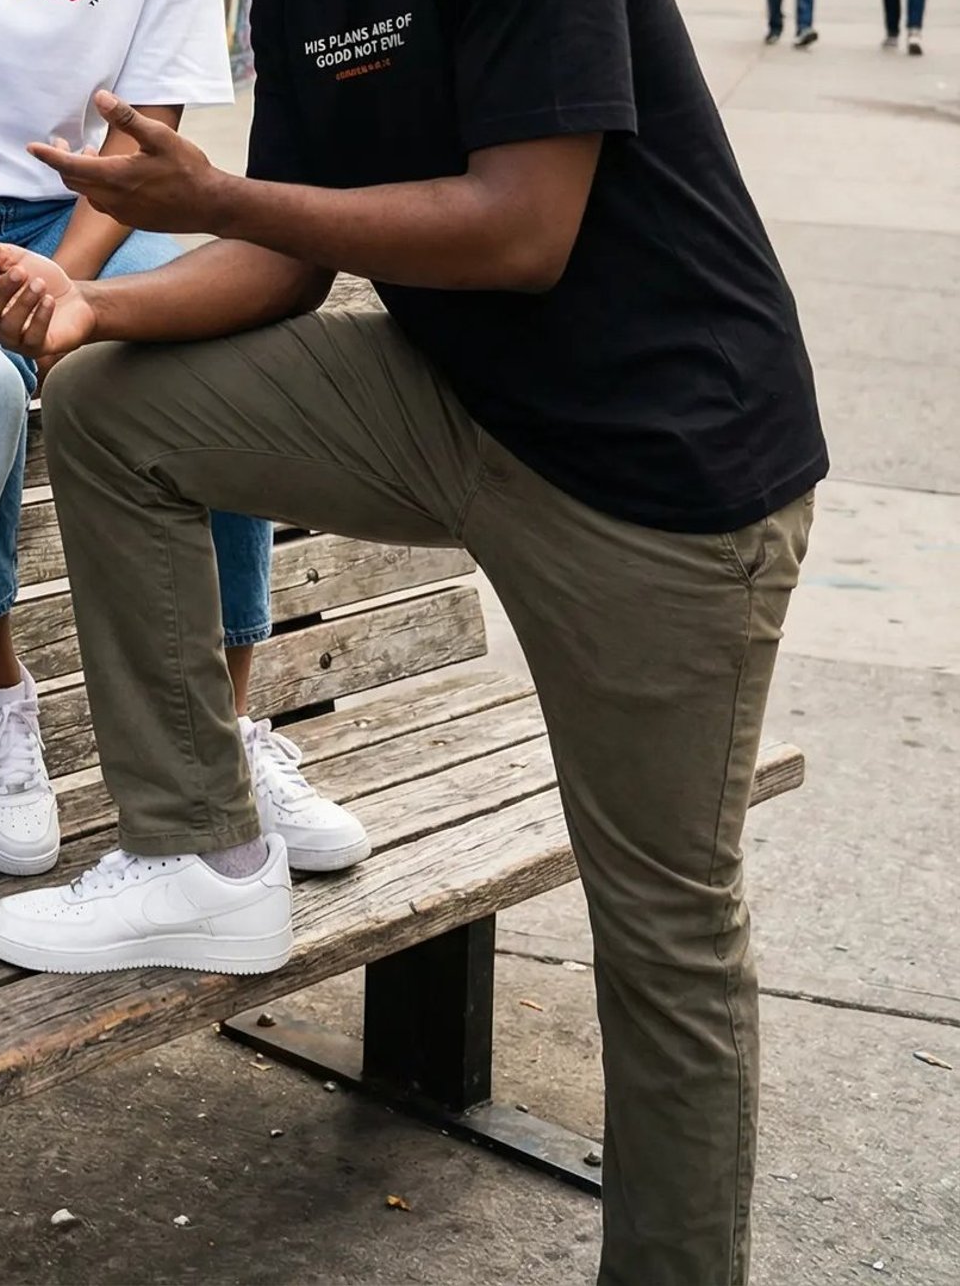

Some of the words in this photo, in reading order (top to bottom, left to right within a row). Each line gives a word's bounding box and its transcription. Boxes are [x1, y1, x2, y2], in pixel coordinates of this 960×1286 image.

[304, 39, 326, 55] HIS
[329, 27, 369, 49] PLANS
[372, 19, 394, 36] ARE
[395, 13, 412, 29] OF
[316, 48, 352, 68] GODD
[354, 40, 378, 59] NOT
[380, 33, 405, 51] EVIL
